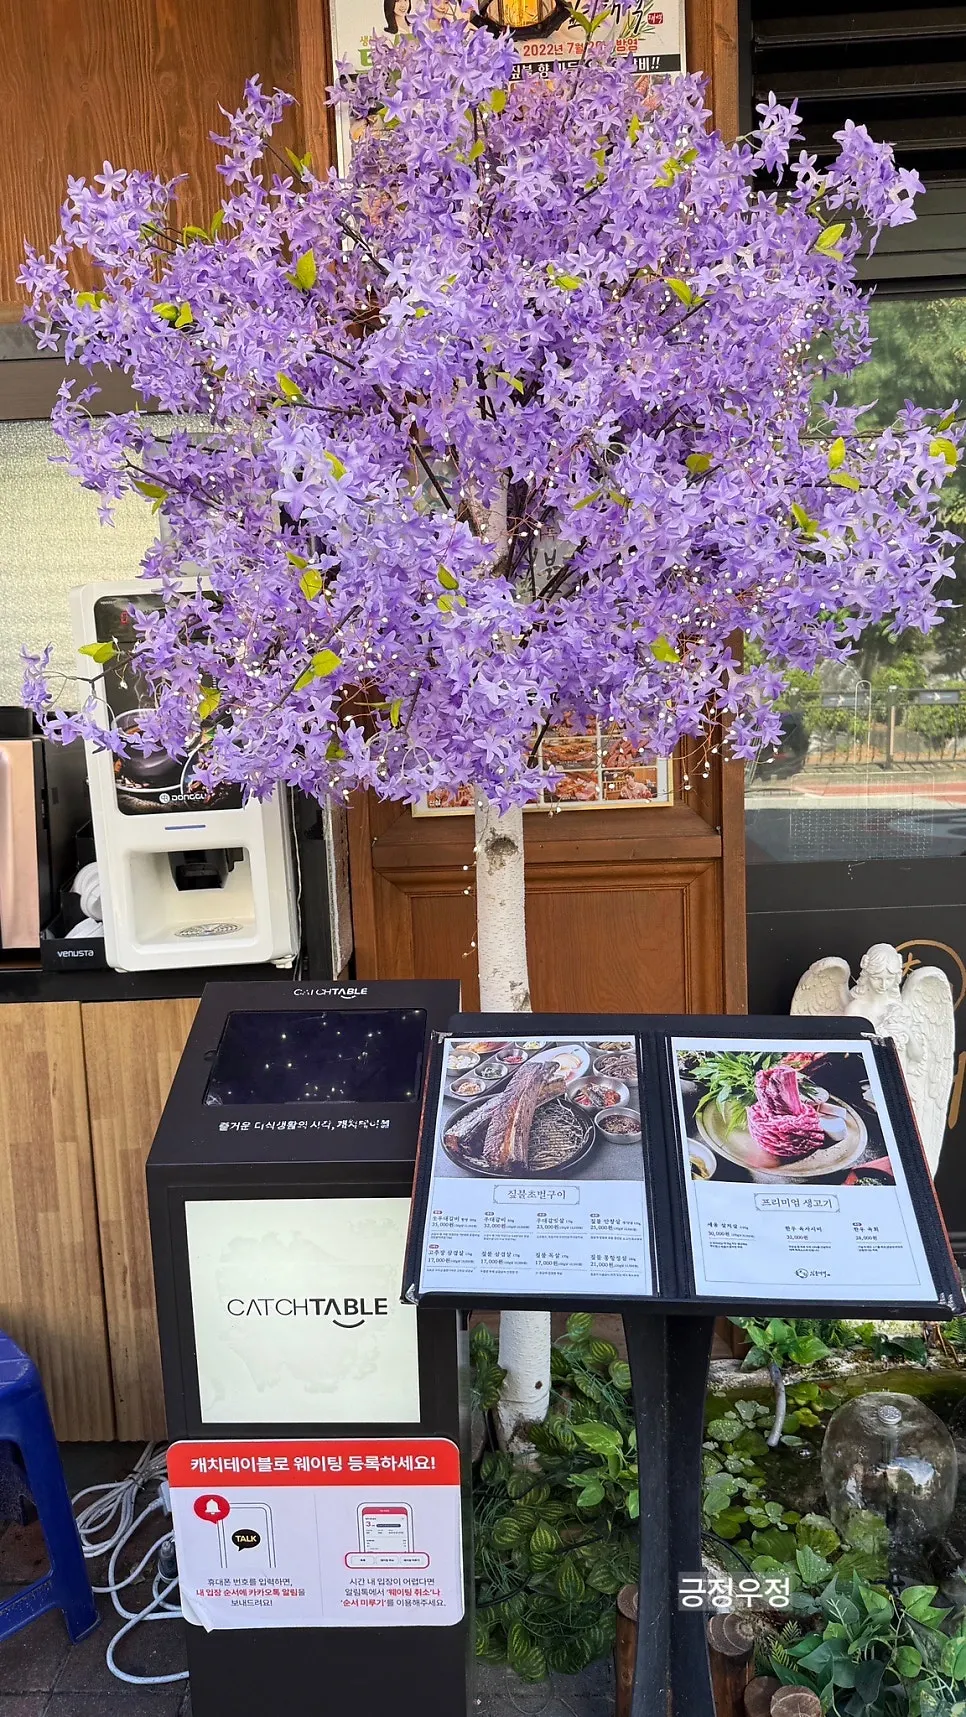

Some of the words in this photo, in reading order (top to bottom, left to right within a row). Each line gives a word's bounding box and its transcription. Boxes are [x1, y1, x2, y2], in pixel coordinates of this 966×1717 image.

[523, 43, 564, 57] 2022년
[616, 38, 639, 52] 방영
[761, 1198, 800, 1209] 프리미엄
[803, 1198, 832, 1209] 생고기
[227, 1298, 388, 1317] CATCHTABLE
[190, 1456, 290, 1473] 캐치테이블로
[293, 1455, 343, 1473] 웨이팅
[347, 1455, 436, 1472] 등록하세요!
[235, 1534, 257, 1543] TALK
[208, 1578, 231, 1587] 휴대폰
[233, 1578, 257, 1587] 번호를
[258, 1578, 293, 1587] 입력하면,
[350, 1578, 365, 1586] 시간
[367, 1578, 376, 1586] 내
[377, 1578, 401, 1586] 입장이
[402, 1578, 435, 1586] 어렵다면
[206, 1588, 221, 1597] 입장
[223, 1588, 247, 1597] 순서에
[248, 1588, 280, 1597] 카카오톡
[345, 1588, 385, 1597] 알림톡에서
[231, 1599, 273, 1607] 보내드려요!
